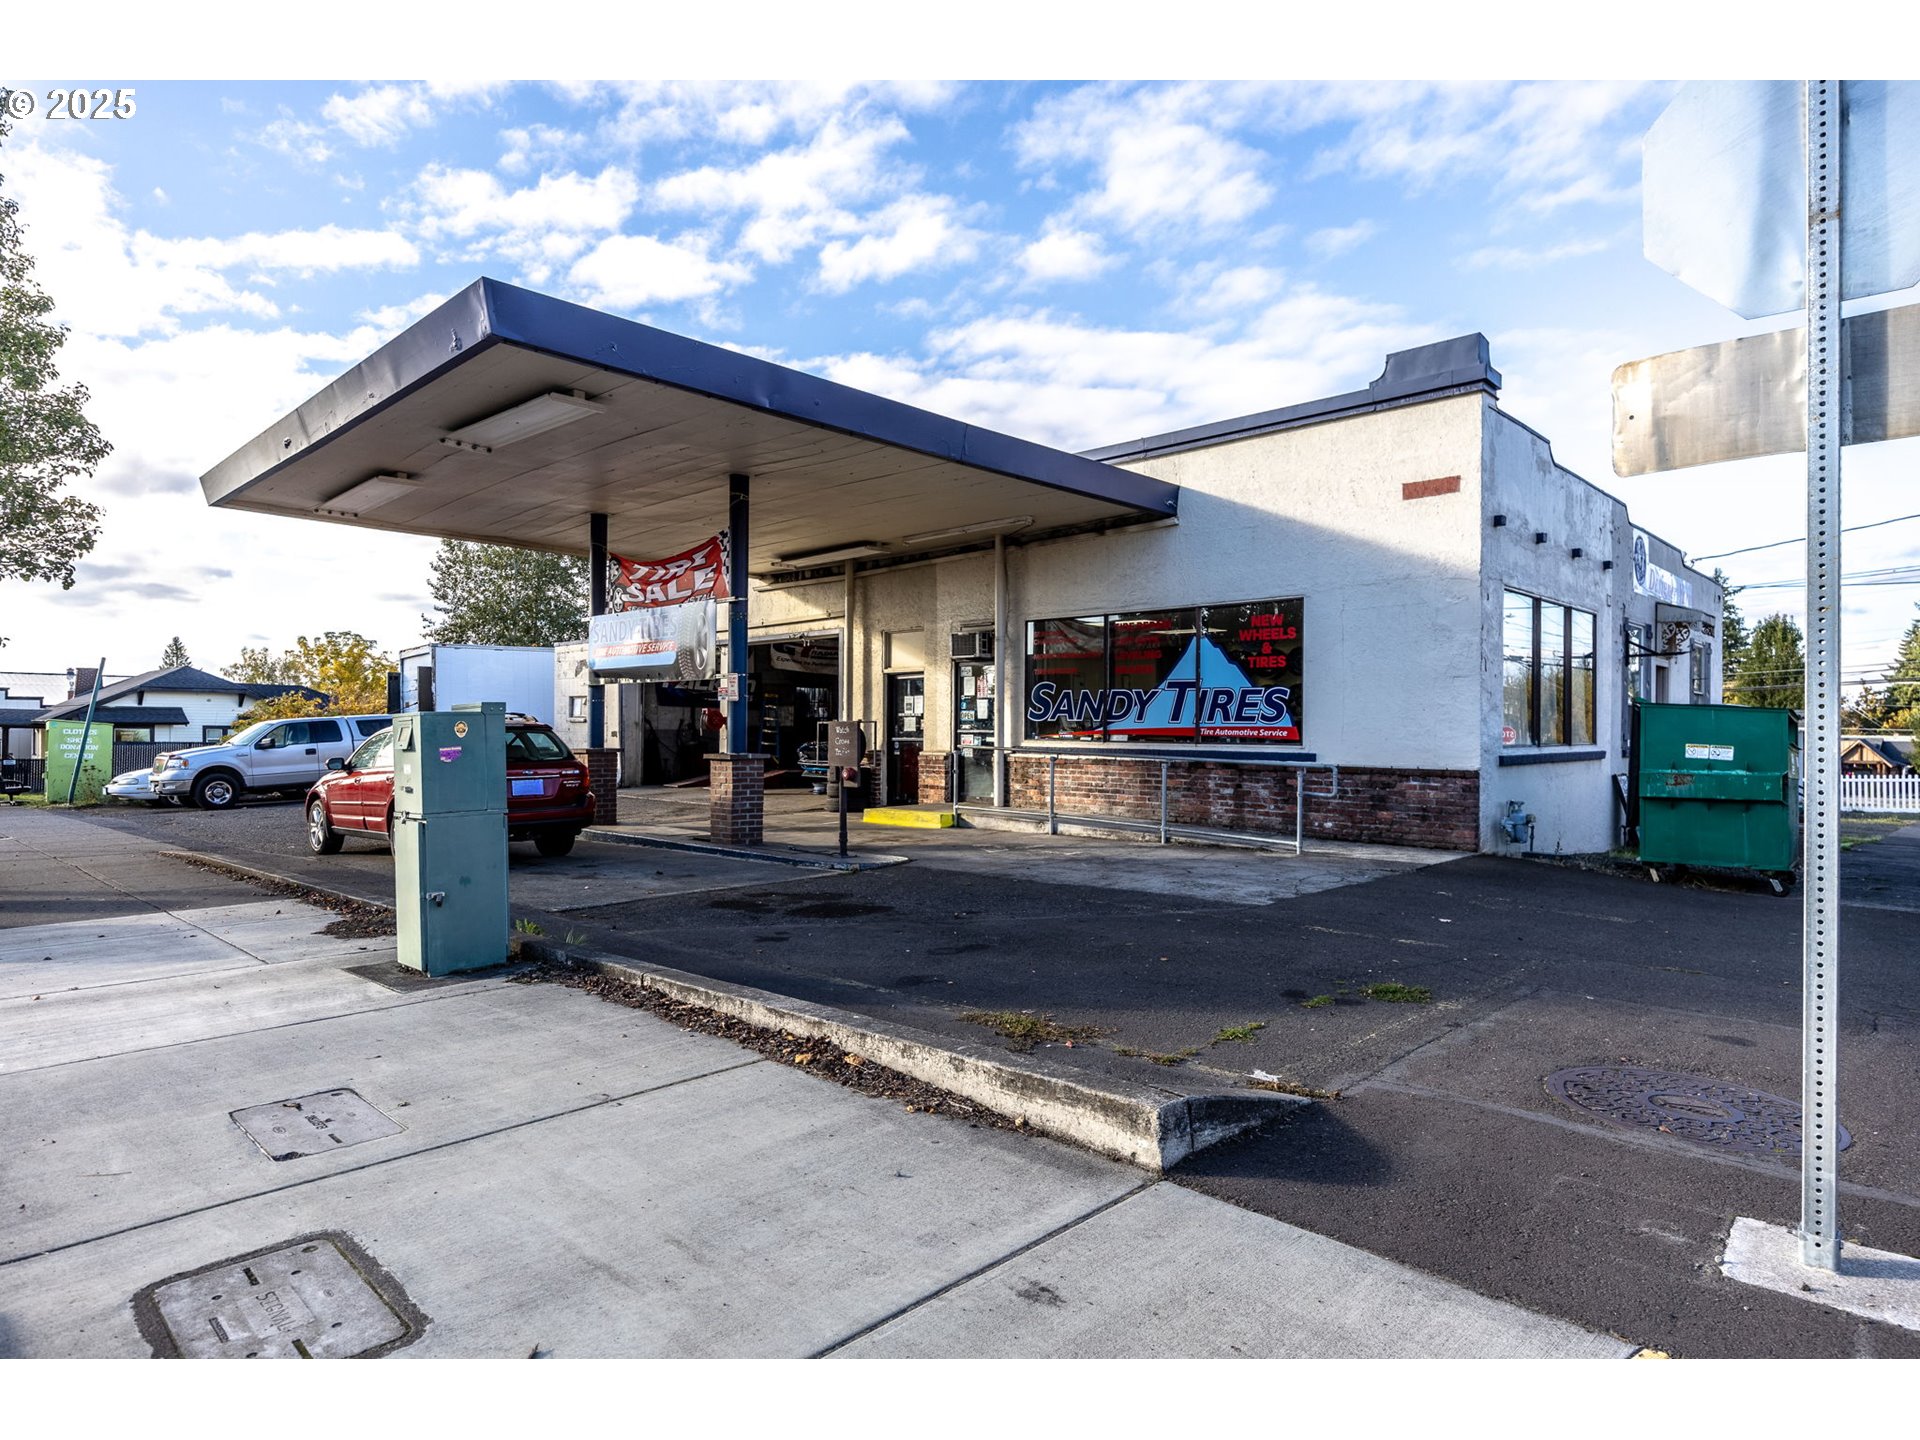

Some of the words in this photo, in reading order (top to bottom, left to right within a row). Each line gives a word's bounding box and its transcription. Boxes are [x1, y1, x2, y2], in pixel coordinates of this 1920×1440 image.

[629, 545, 714, 581] TIRE
[621, 562, 717, 603] SALE
[1251, 614, 1283, 627] NEW
[592, 617, 635, 644] SANDY
[639, 613, 678, 640] TIRES
[1239, 627, 1297, 641] WHEELS
[648, 640, 674, 653] SERVICE
[1262, 642, 1272, 654] &
[1248, 655, 1287, 669] TIRES
[1028, 681, 1161, 723] SANDY
[1165, 679, 1290, 724] TIRES
[1200, 728, 1214, 736] Tire
[1259, 729, 1288, 737] Service
